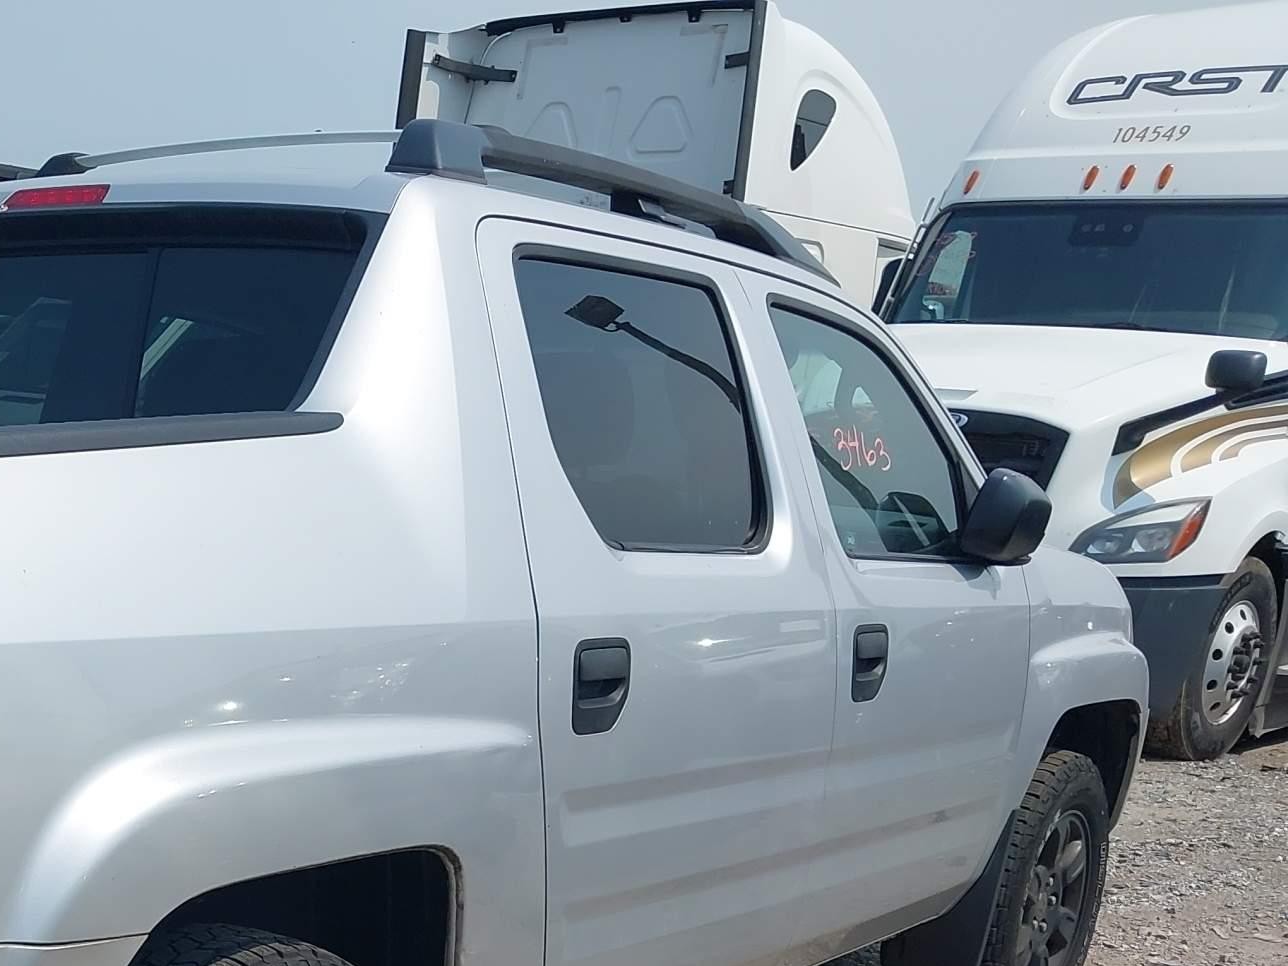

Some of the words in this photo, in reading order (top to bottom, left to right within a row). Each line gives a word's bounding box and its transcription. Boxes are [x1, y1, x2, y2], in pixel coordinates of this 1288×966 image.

[1066, 65, 1288, 105] CRST
[1113, 125, 1191, 143] 104549
[833, 425, 891, 471] 3463
